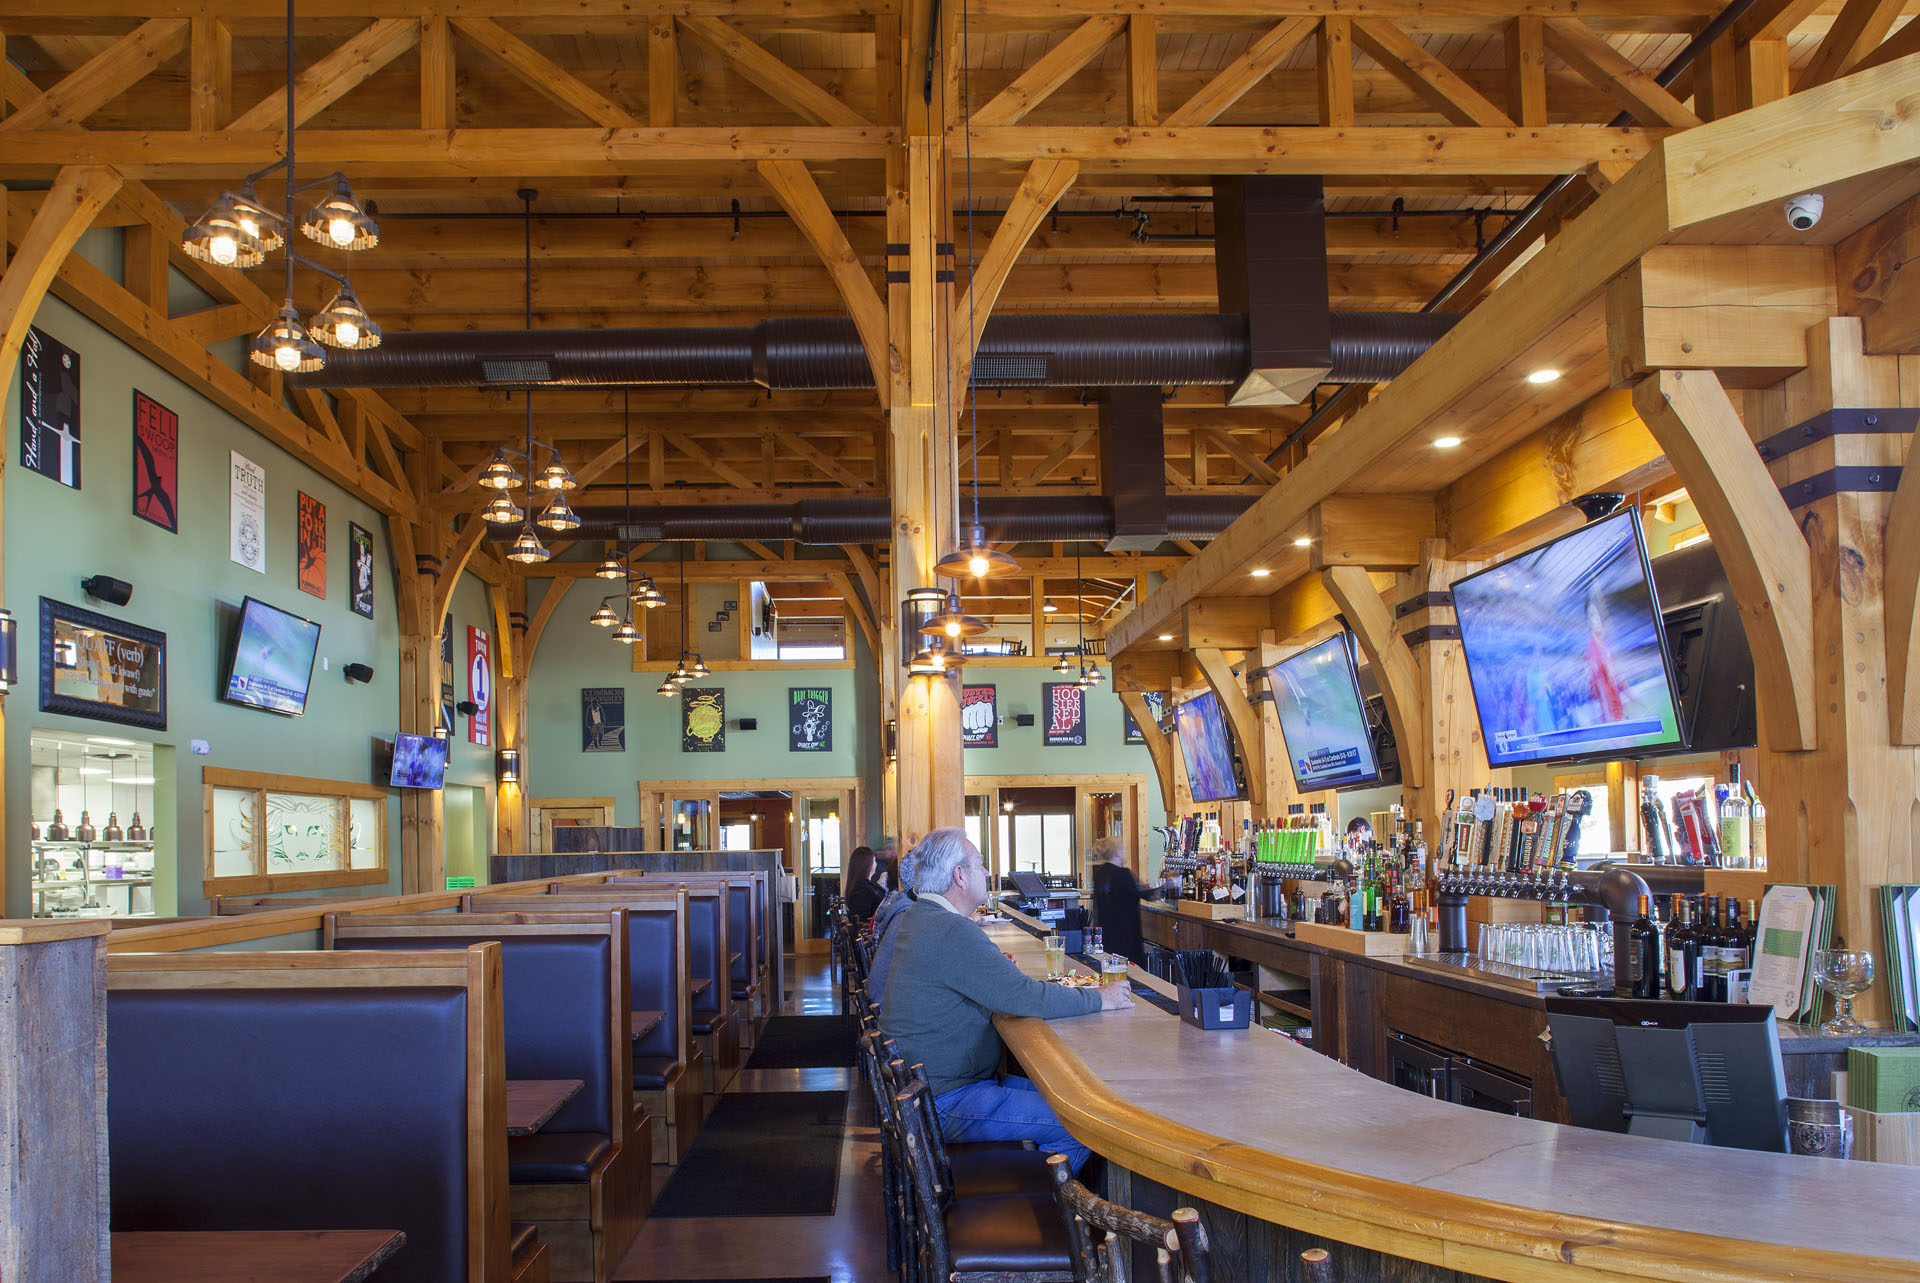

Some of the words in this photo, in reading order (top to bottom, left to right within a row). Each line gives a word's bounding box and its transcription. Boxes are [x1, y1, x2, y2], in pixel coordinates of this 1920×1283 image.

[26, 381, 37, 416] and
[139, 398, 175, 441] FELL
[25, 416, 37, 468] Hand
[139, 425, 175, 451] SWOOP
[234, 464, 264, 494] TRUTH
[300, 492, 317, 513] PUT
[318, 504, 325, 519] A
[300, 510, 325, 539] FORK
[75, 631, 116, 656] QUAFF
[117, 643, 145, 668] (verb)
[125, 682, 138, 695] with
[477, 656, 485, 700] 1
[963, 688, 994, 697] USTED
[1053, 689, 1080, 700] HOO
[1053, 700, 1080, 709] SIER
[1053, 709, 1080, 719] RED
